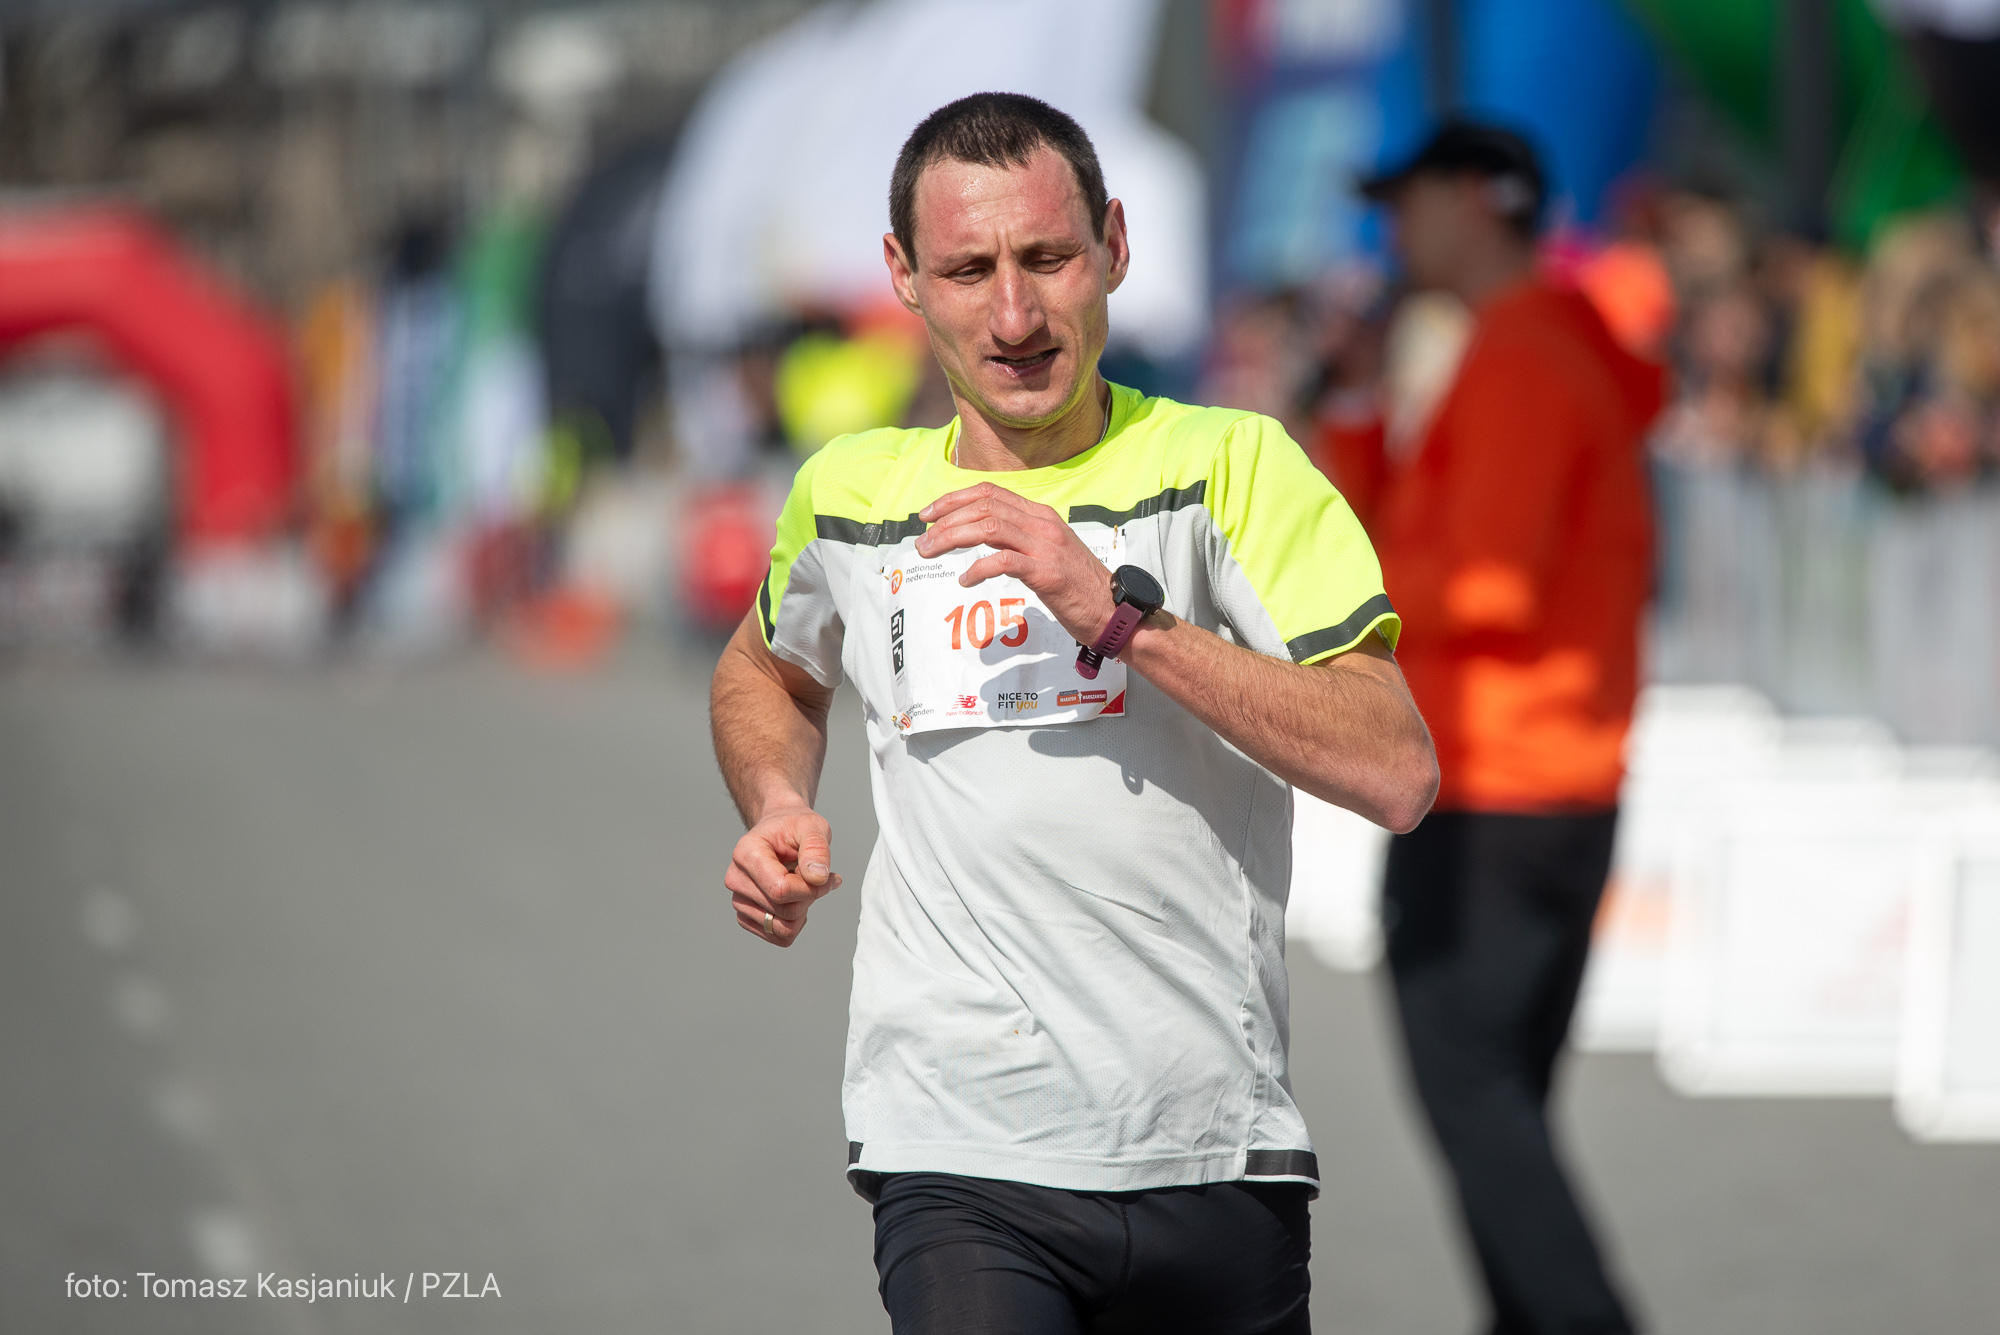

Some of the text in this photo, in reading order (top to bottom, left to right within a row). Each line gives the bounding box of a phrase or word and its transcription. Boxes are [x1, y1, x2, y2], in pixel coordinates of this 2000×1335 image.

[906, 563, 943, 575] nationale
[905, 571, 956, 584] nederlanden
[943, 598, 1029, 650] 105
[998, 692, 1039, 701] NICE TO
